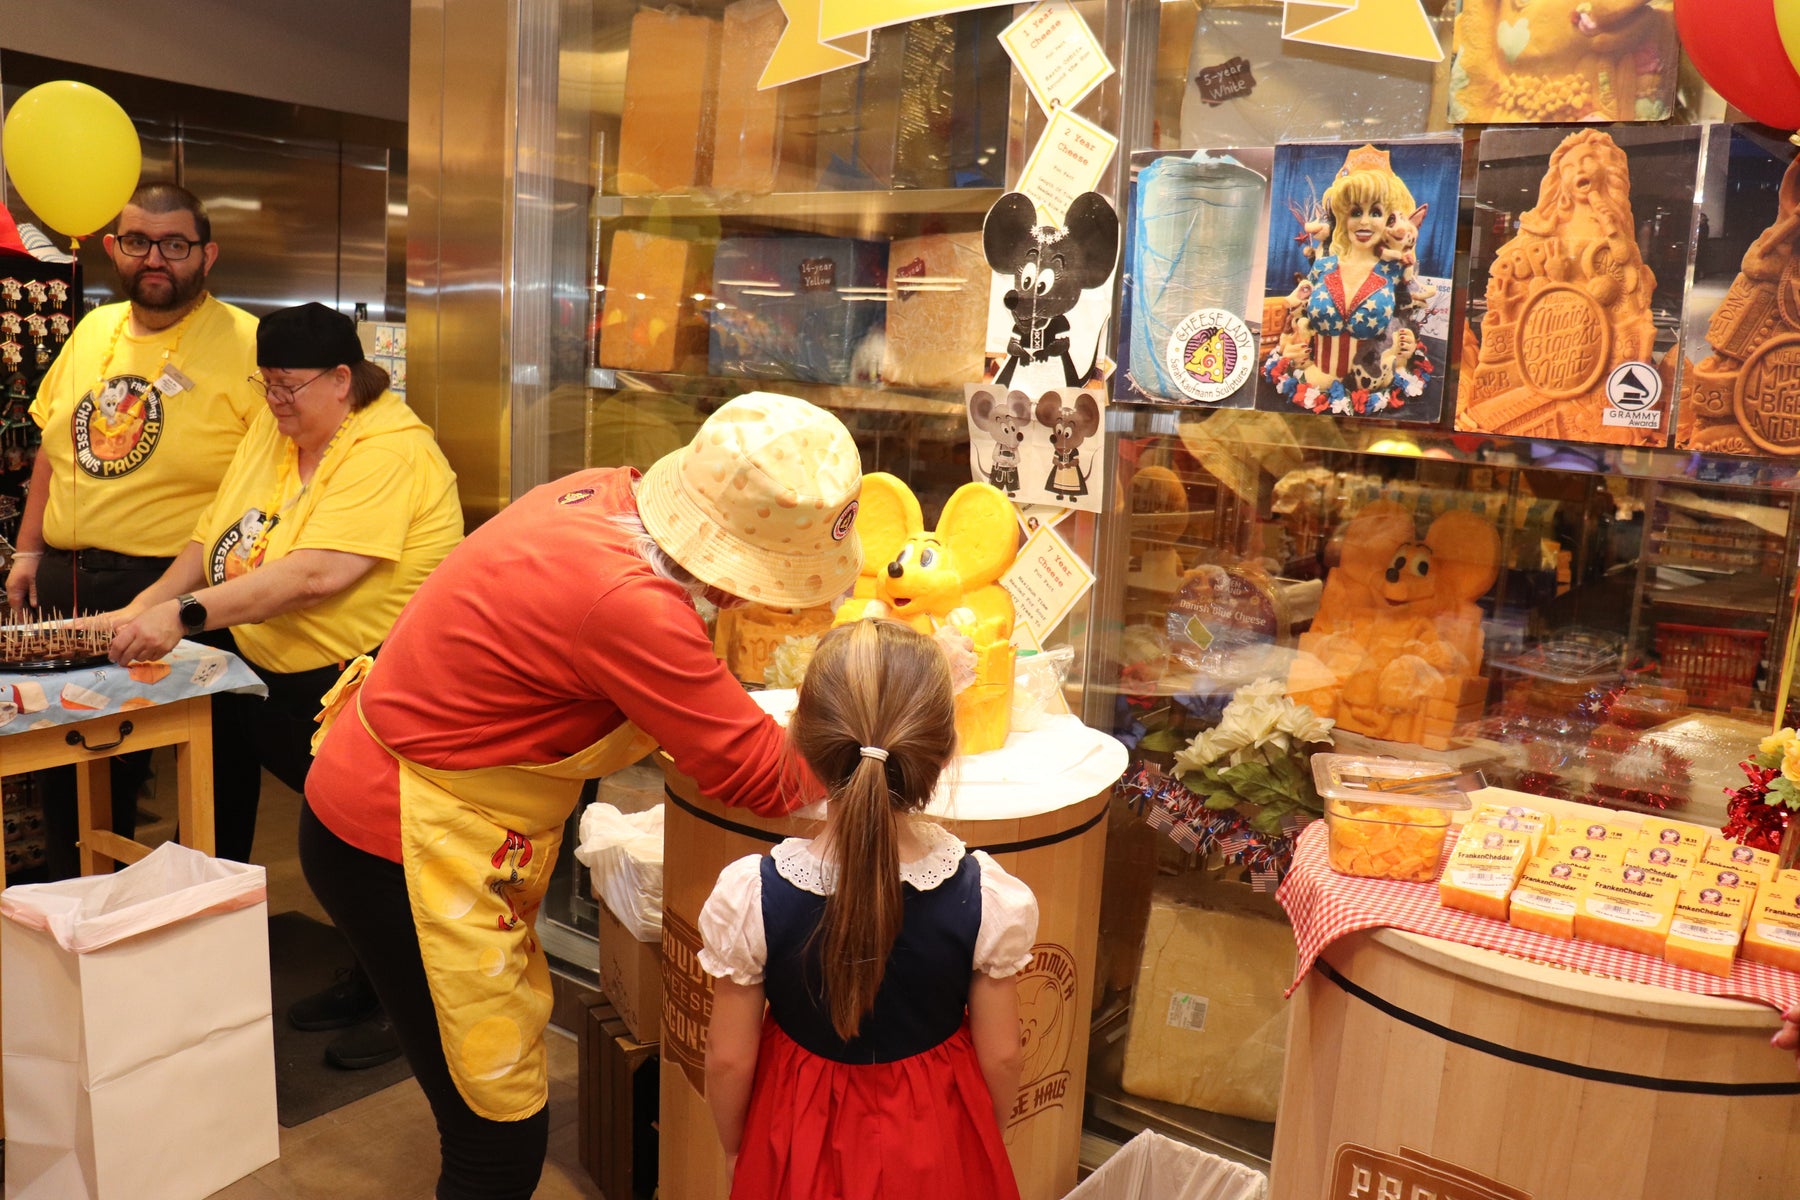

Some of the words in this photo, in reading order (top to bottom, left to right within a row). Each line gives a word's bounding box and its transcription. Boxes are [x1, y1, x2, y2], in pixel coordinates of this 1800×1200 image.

[1032, 8, 1055, 27] Year
[1030, 21, 1063, 48] Cheese
[1204, 64, 1242, 86] 5-year
[1209, 80, 1246, 99] White
[1064, 128, 1072, 136] 2
[1075, 135, 1096, 150] Year
[1058, 143, 1089, 164] Cheese
[801, 262, 833, 275] 14-year
[804, 276, 831, 287] Yellow
[1176, 312, 1223, 342] CHEESE
[1224, 317, 1252, 348] LADY
[1171, 358, 1183, 380] Sarah
[1180, 376, 1214, 398] Kaufmann
[1215, 366, 1248, 398] Sculptures
[75, 401, 93, 450] CHEESE
[1609, 410, 1659, 421] GRAMMY
[1628, 419, 1658, 428] Awards
[103, 421, 160, 476] PALOOZA
[78, 448, 101, 473] HAUS
[213, 530, 239, 582] CHEESE
[1055, 556, 1073, 576] Year
[1038, 557, 1065, 586] Cheese
[1180, 599, 1210, 613] Danish
[1212, 606, 1232, 618] Blue
[1234, 611, 1266, 626] Cheese
[1458, 851, 1513, 861] FrankenCheddar
[1522, 874, 1577, 891] FrankenCheddar
[1594, 881, 1654, 899] FrankenCheddar
[1675, 903, 1732, 918] rankenCheddar
[1017, 951, 1075, 1001] ENMUTH
[1033, 1077, 1068, 1109] HAUS
